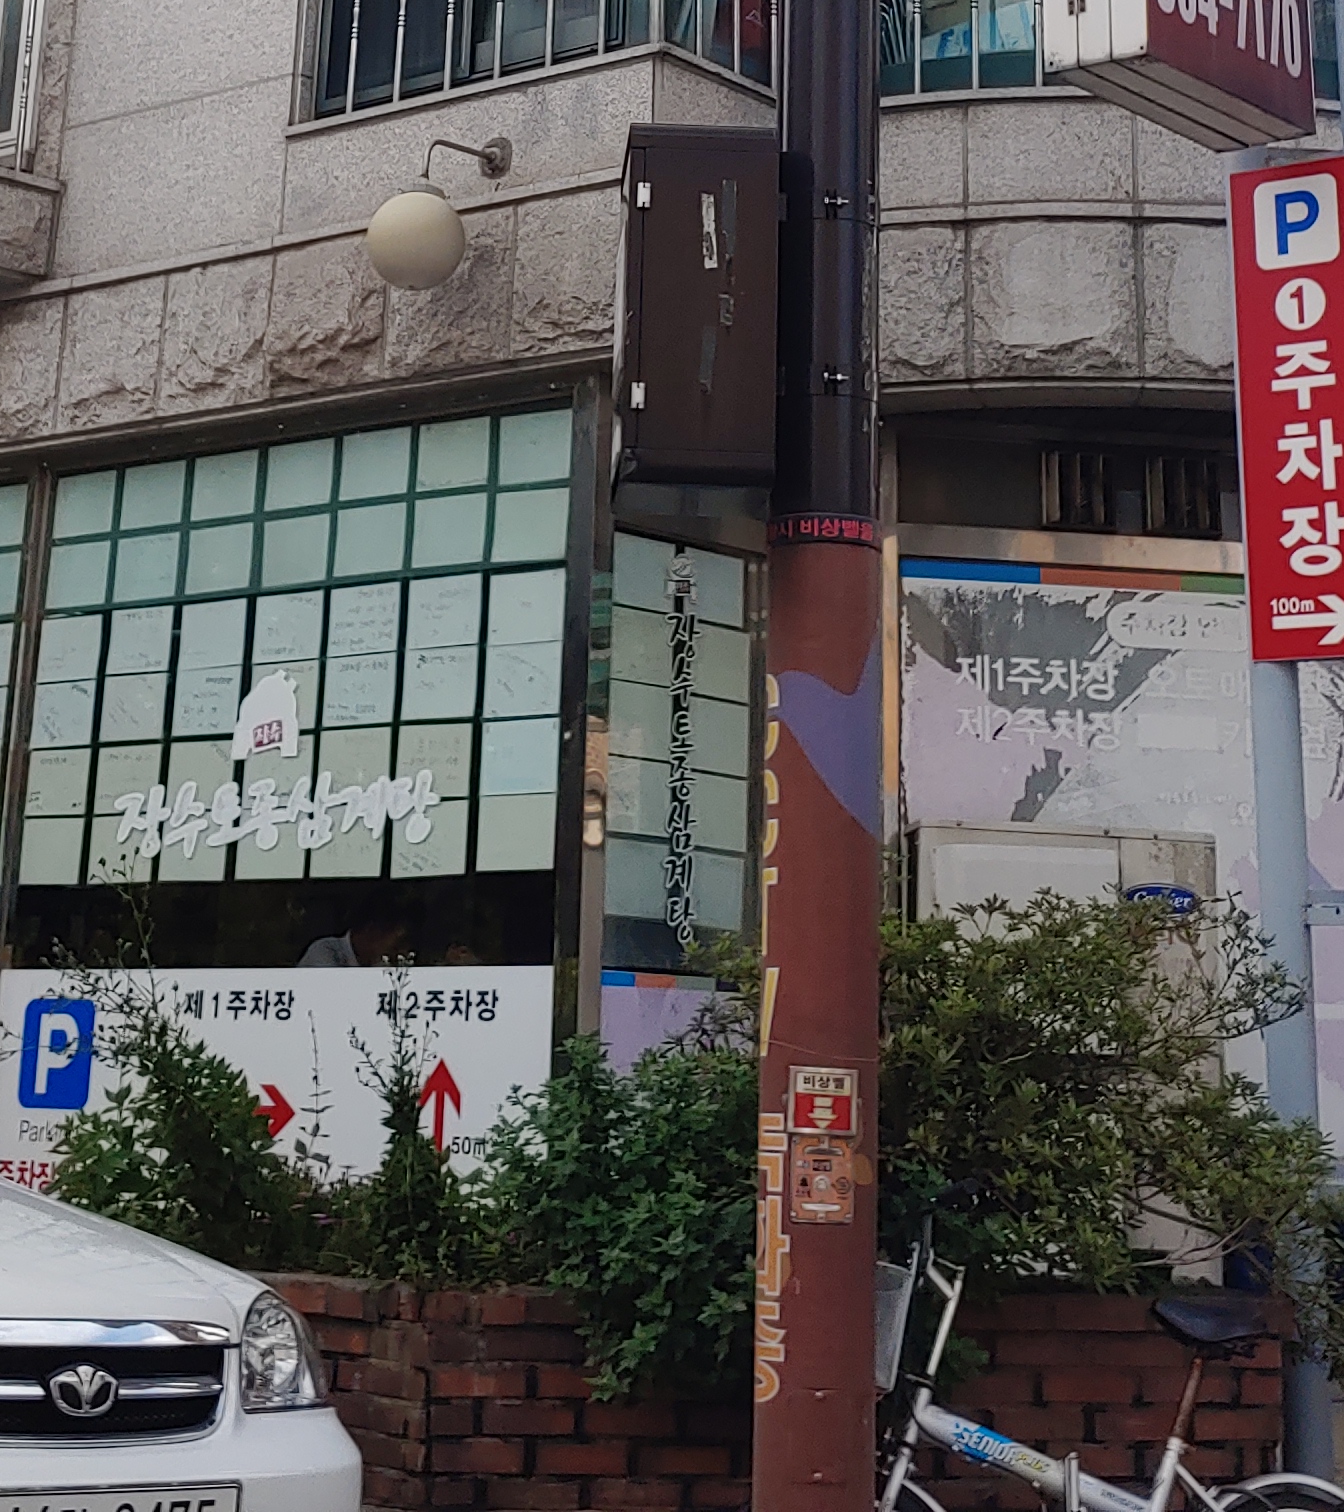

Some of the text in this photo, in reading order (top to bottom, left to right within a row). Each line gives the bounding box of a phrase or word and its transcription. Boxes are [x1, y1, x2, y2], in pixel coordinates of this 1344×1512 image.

[1274, 190, 1320, 256] P
[1269, 596, 1315, 615] 100m
[954, 654, 1119, 703] 제1주차장
[954, 706, 1122, 751] 제2주차장
